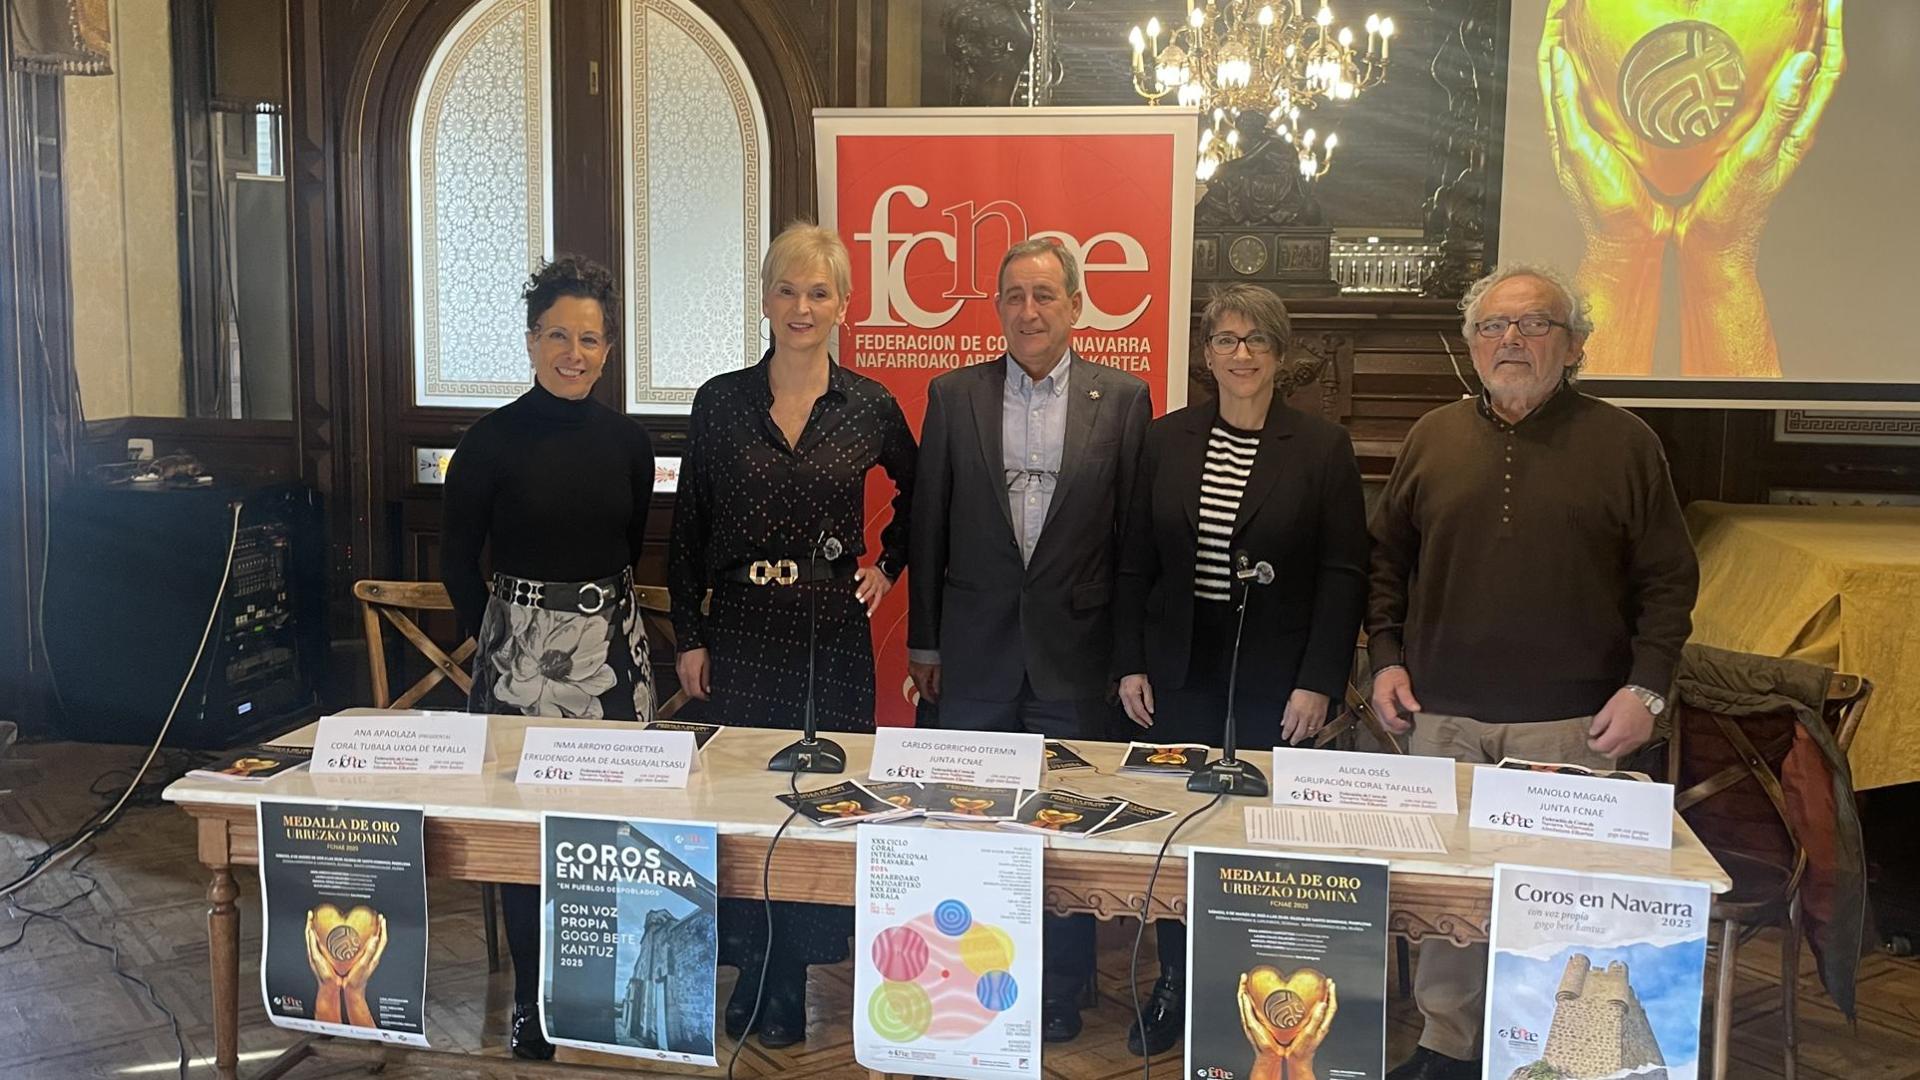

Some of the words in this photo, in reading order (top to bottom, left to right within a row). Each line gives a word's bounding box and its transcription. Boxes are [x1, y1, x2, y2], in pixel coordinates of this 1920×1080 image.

[856, 335, 955, 351] FEDERACION
[961, 336, 982, 351] DE
[1072, 336, 1151, 352] NAVARRA
[856, 352, 960, 369] NAFARROAKO
[354, 729, 372, 737] ANA
[374, 730, 416, 738] APAOLAZA
[331, 742, 357, 750] CORAL
[360, 743, 392, 751] TUBALA
[394, 744, 417, 752] UXOA
[553, 741, 576, 749] INMA
[578, 743, 611, 751] ARROYO
[613, 744, 664, 753] GOIKOETXEA
[902, 741, 932, 749] CARLOS
[934, 743, 977, 752] GORRICHO
[978, 747, 1016, 755] OTERMIN
[524, 753, 574, 762] ERKUDENGO
[610, 758, 685, 768] ALSASUA/ALTSASU
[958, 758, 983, 766] FCNAE
[1339, 766, 1365, 775] ALICIA
[1368, 767, 1390, 777] OSÉS
[1294, 776, 1352, 787] AGRUPACIÓN
[1355, 781, 1382, 790] CORAL
[1386, 784, 1432, 794] TAFALLESA
[1528, 786, 1570, 798] MANOLO
[1573, 792, 1618, 804] MAGAÑA
[1540, 803, 1570, 813] JUNTA
[1573, 806, 1604, 817] FCNAE
[283, 816, 347, 830] MEDALLA
[351, 819, 368, 831] DE
[372, 820, 400, 833] ORO
[287, 828, 345, 841] URREZKO
[348, 832, 397, 846] DOMINA
[872, 838, 885, 846] XXX
[556, 842, 661, 869] COROS
[871, 852, 928, 861] INTERNACIONAL
[882, 858, 914, 866] NAVARRA
[557, 863, 583, 879] EN
[593, 865, 696, 888] NAVARRA
[871, 873, 920, 882] NAFARROAKO
[1220, 868, 1296, 884] MEDALLA
[1301, 873, 1323, 886] DE
[1326, 875, 1361, 890] ORO
[572, 884, 604, 892] PUEBLOS
[871, 880, 921, 888] NAZIOARTEKO
[1223, 882, 1292, 898] URREZKO
[1297, 887, 1358, 903] DOMINA
[1270, 900, 1292, 908] FCNAE
[1515, 883, 1574, 906] Coros
[1580, 893, 1604, 908] en
[1611, 892, 1693, 918] Navarra
[561, 904, 588, 915] CON
[592, 906, 618, 917] VOZ
[1528, 907, 1543, 916] con
[1545, 910, 1559, 919] voz
[1561, 910, 1589, 922] propia
[561, 917, 609, 929] PROPIA
[1534, 920, 1554, 931] gogo
[1556, 920, 1574, 932] bete
[1661, 917, 1691, 928] 2025
[561, 930, 599, 941] GOGO
[603, 933, 636, 944] BETE
[561, 944, 614, 957] KANTUZ
[561, 958, 583, 967] 2025
